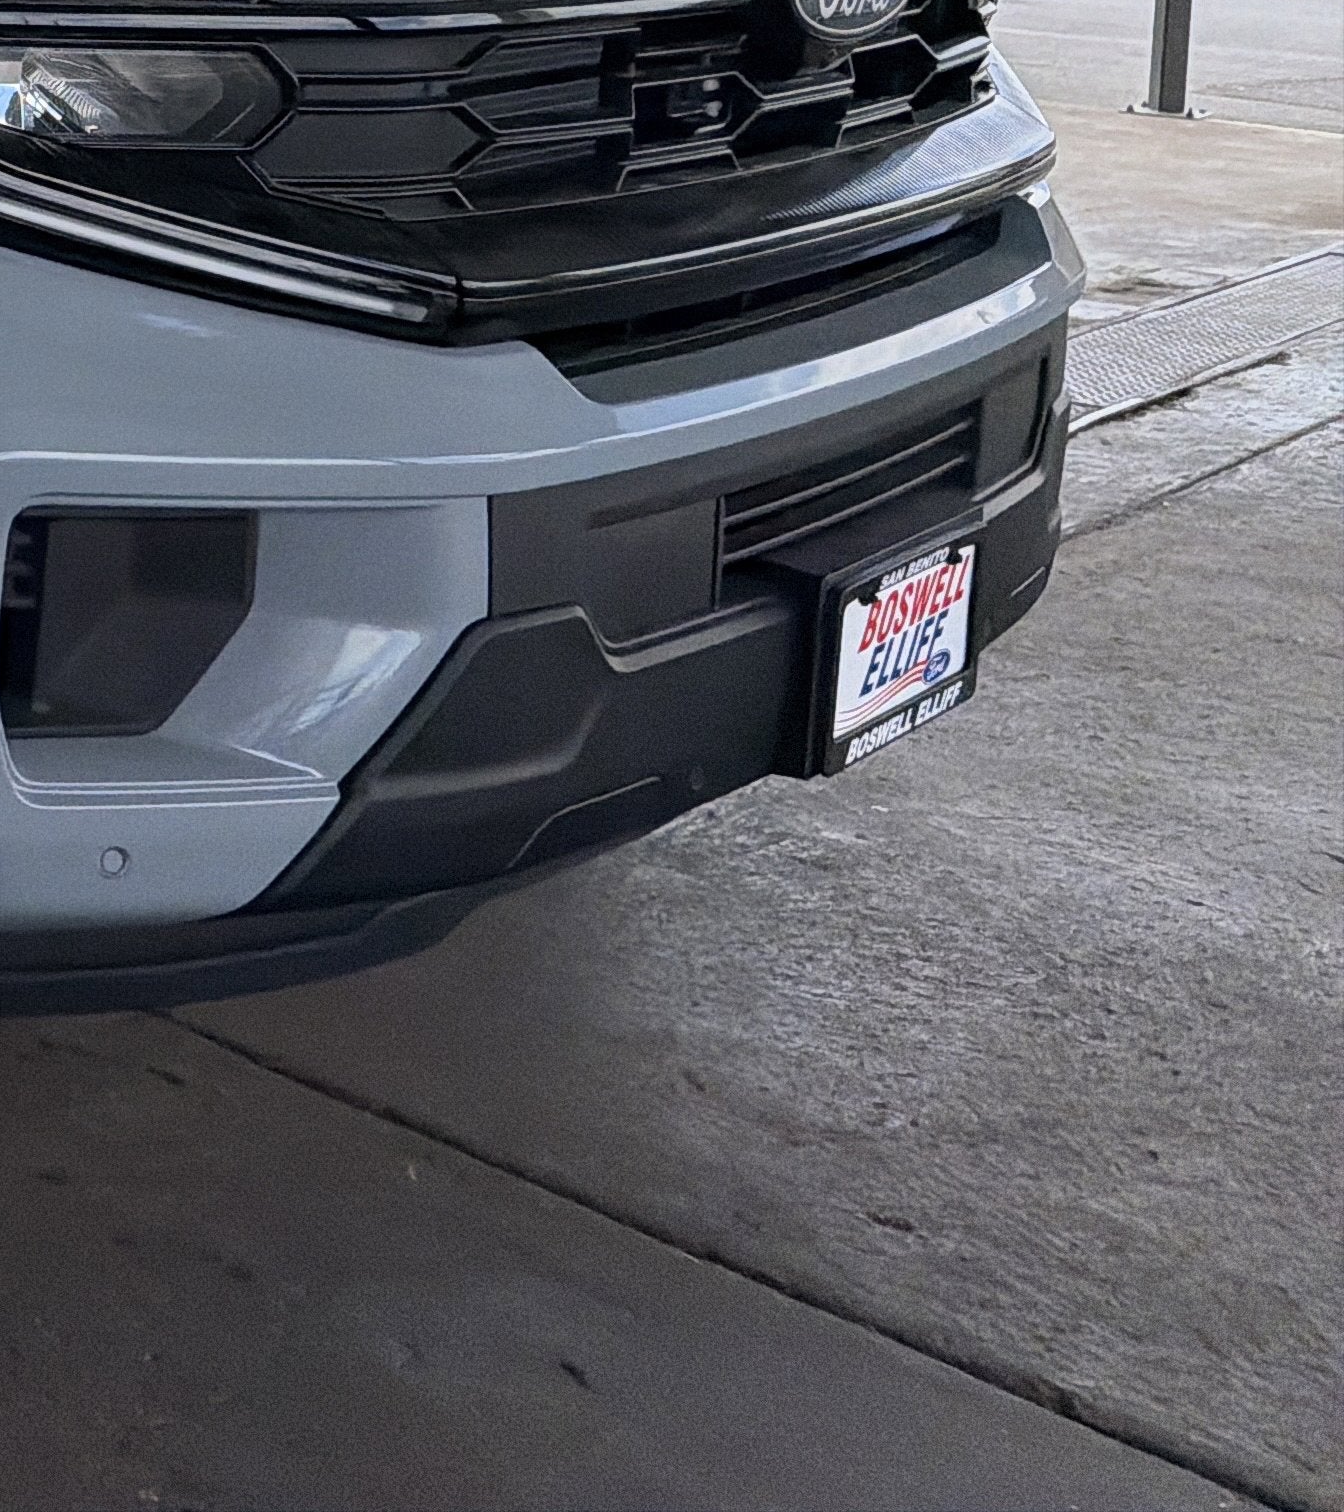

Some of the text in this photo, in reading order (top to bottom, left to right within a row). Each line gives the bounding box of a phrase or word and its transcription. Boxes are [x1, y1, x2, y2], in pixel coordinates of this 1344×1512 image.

[858, 554, 971, 654] BOSWELL
[880, 546, 950, 589] SAN BENITO
[858, 608, 950, 699] ELLIFF
[844, 681, 963, 766] BOSWELL ELLIFF
